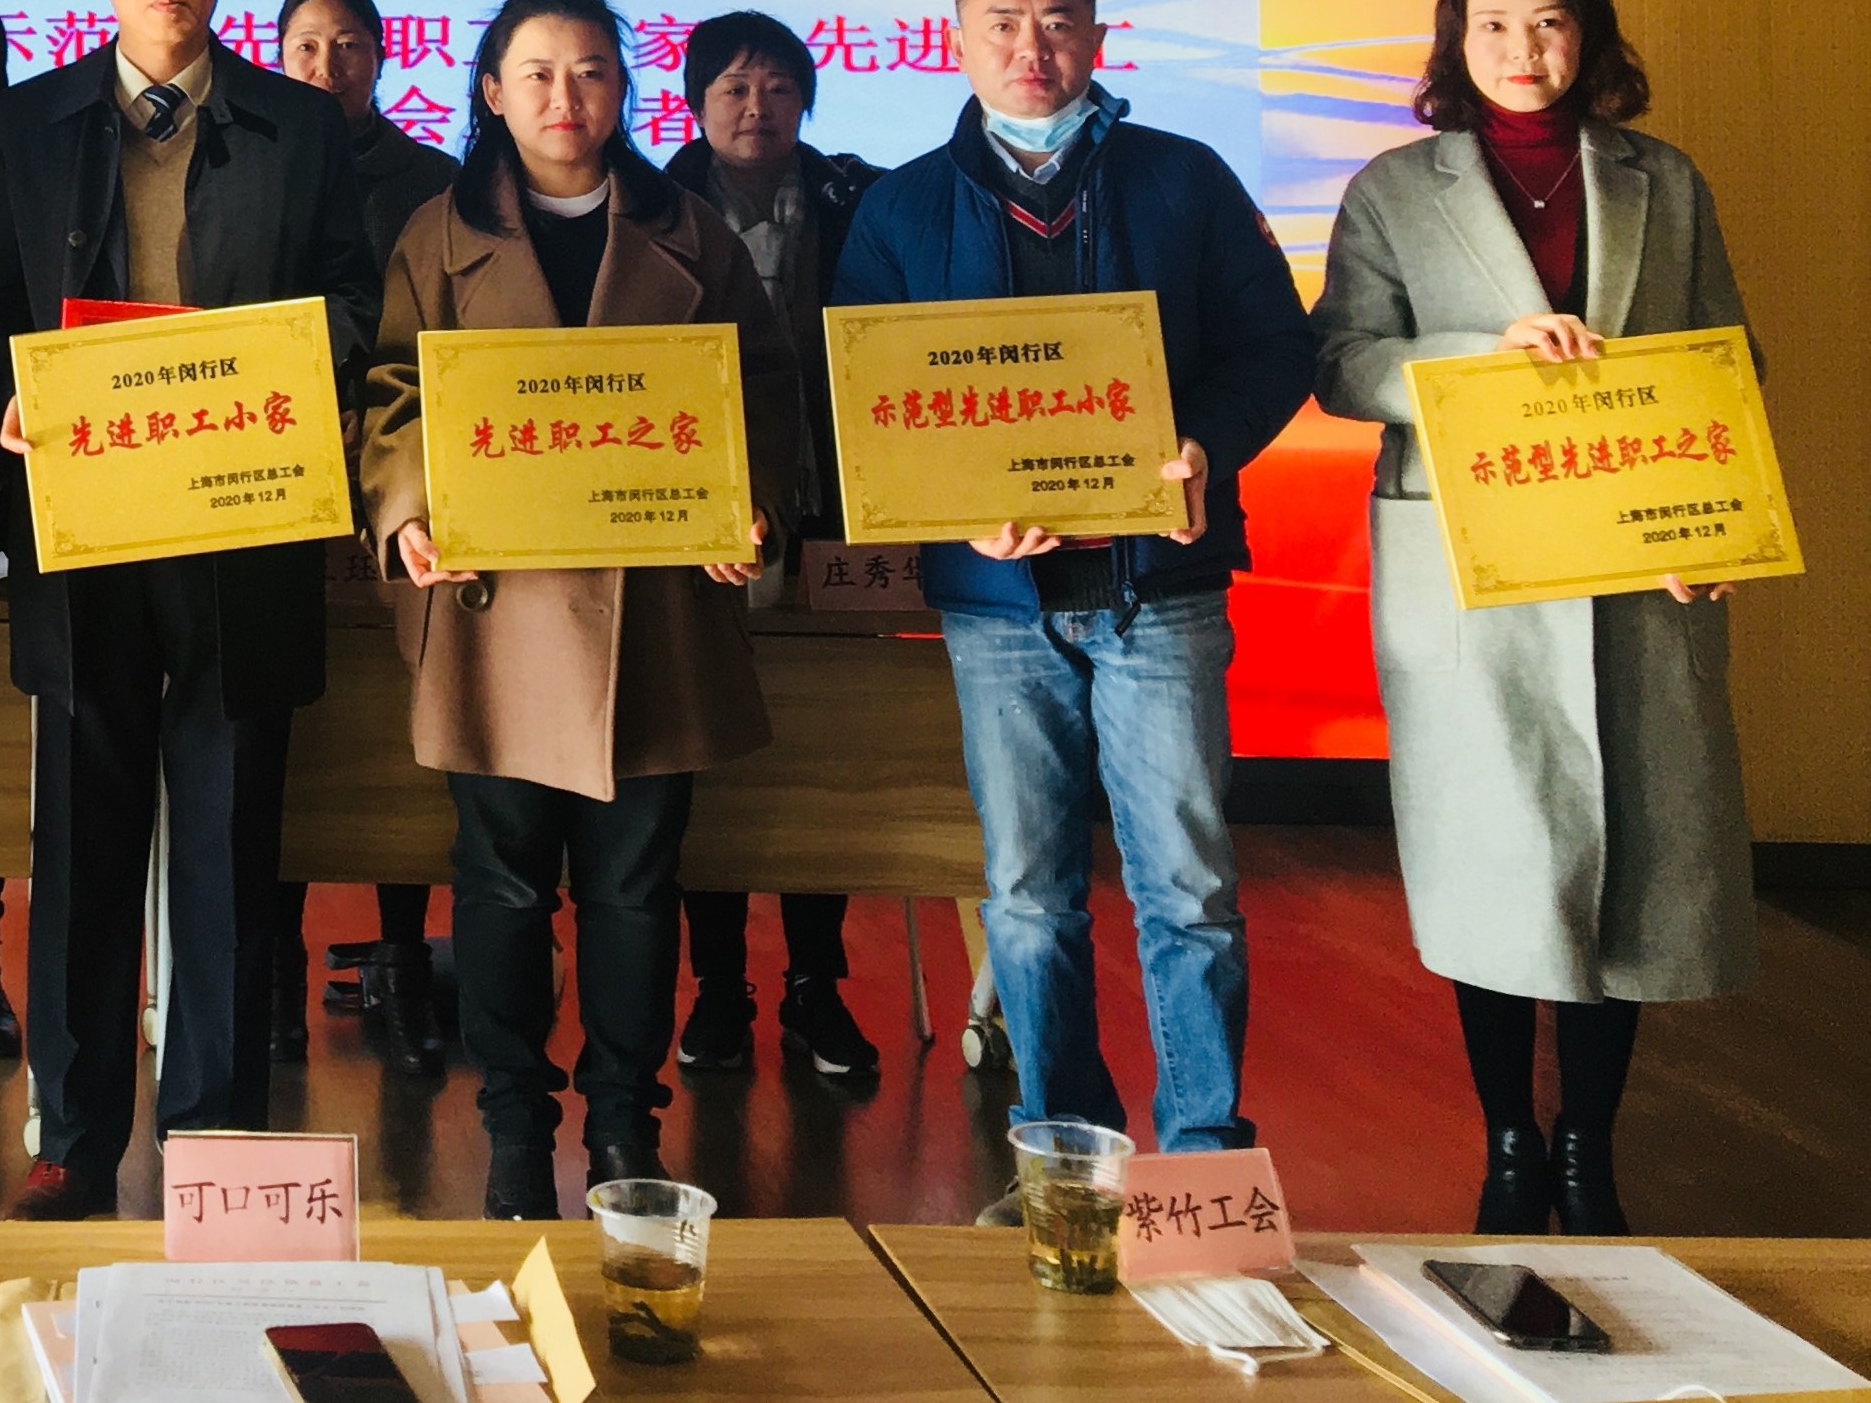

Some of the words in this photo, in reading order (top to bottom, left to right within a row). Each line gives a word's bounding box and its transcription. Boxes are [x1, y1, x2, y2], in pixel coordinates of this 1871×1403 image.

[928, 341, 1064, 366] 2020年闵行区
[111, 356, 239, 390] 2020年闵行区
[517, 372, 647, 395] 2020年闵行区
[871, 377, 1136, 430] 示范型先进职工小家
[1522, 384, 1660, 418] 2020年闵行区
[68, 391, 298, 457] 先进职工小家
[470, 410, 703, 459] 先进职工之家
[1007, 453, 1135, 473] 上海市闵行区总工会
[1470, 420, 1737, 487] 示范型先进职工之家
[187, 463, 305, 491] 上海市闵行区总工会
[588, 486, 709, 503] 上海市闵行区总工会
[1616, 498, 1744, 525] 上海市闵行区总工会
[171, 1178, 343, 1224] 可口可乐
[1126, 1186, 1279, 1243] 紫竹工会
